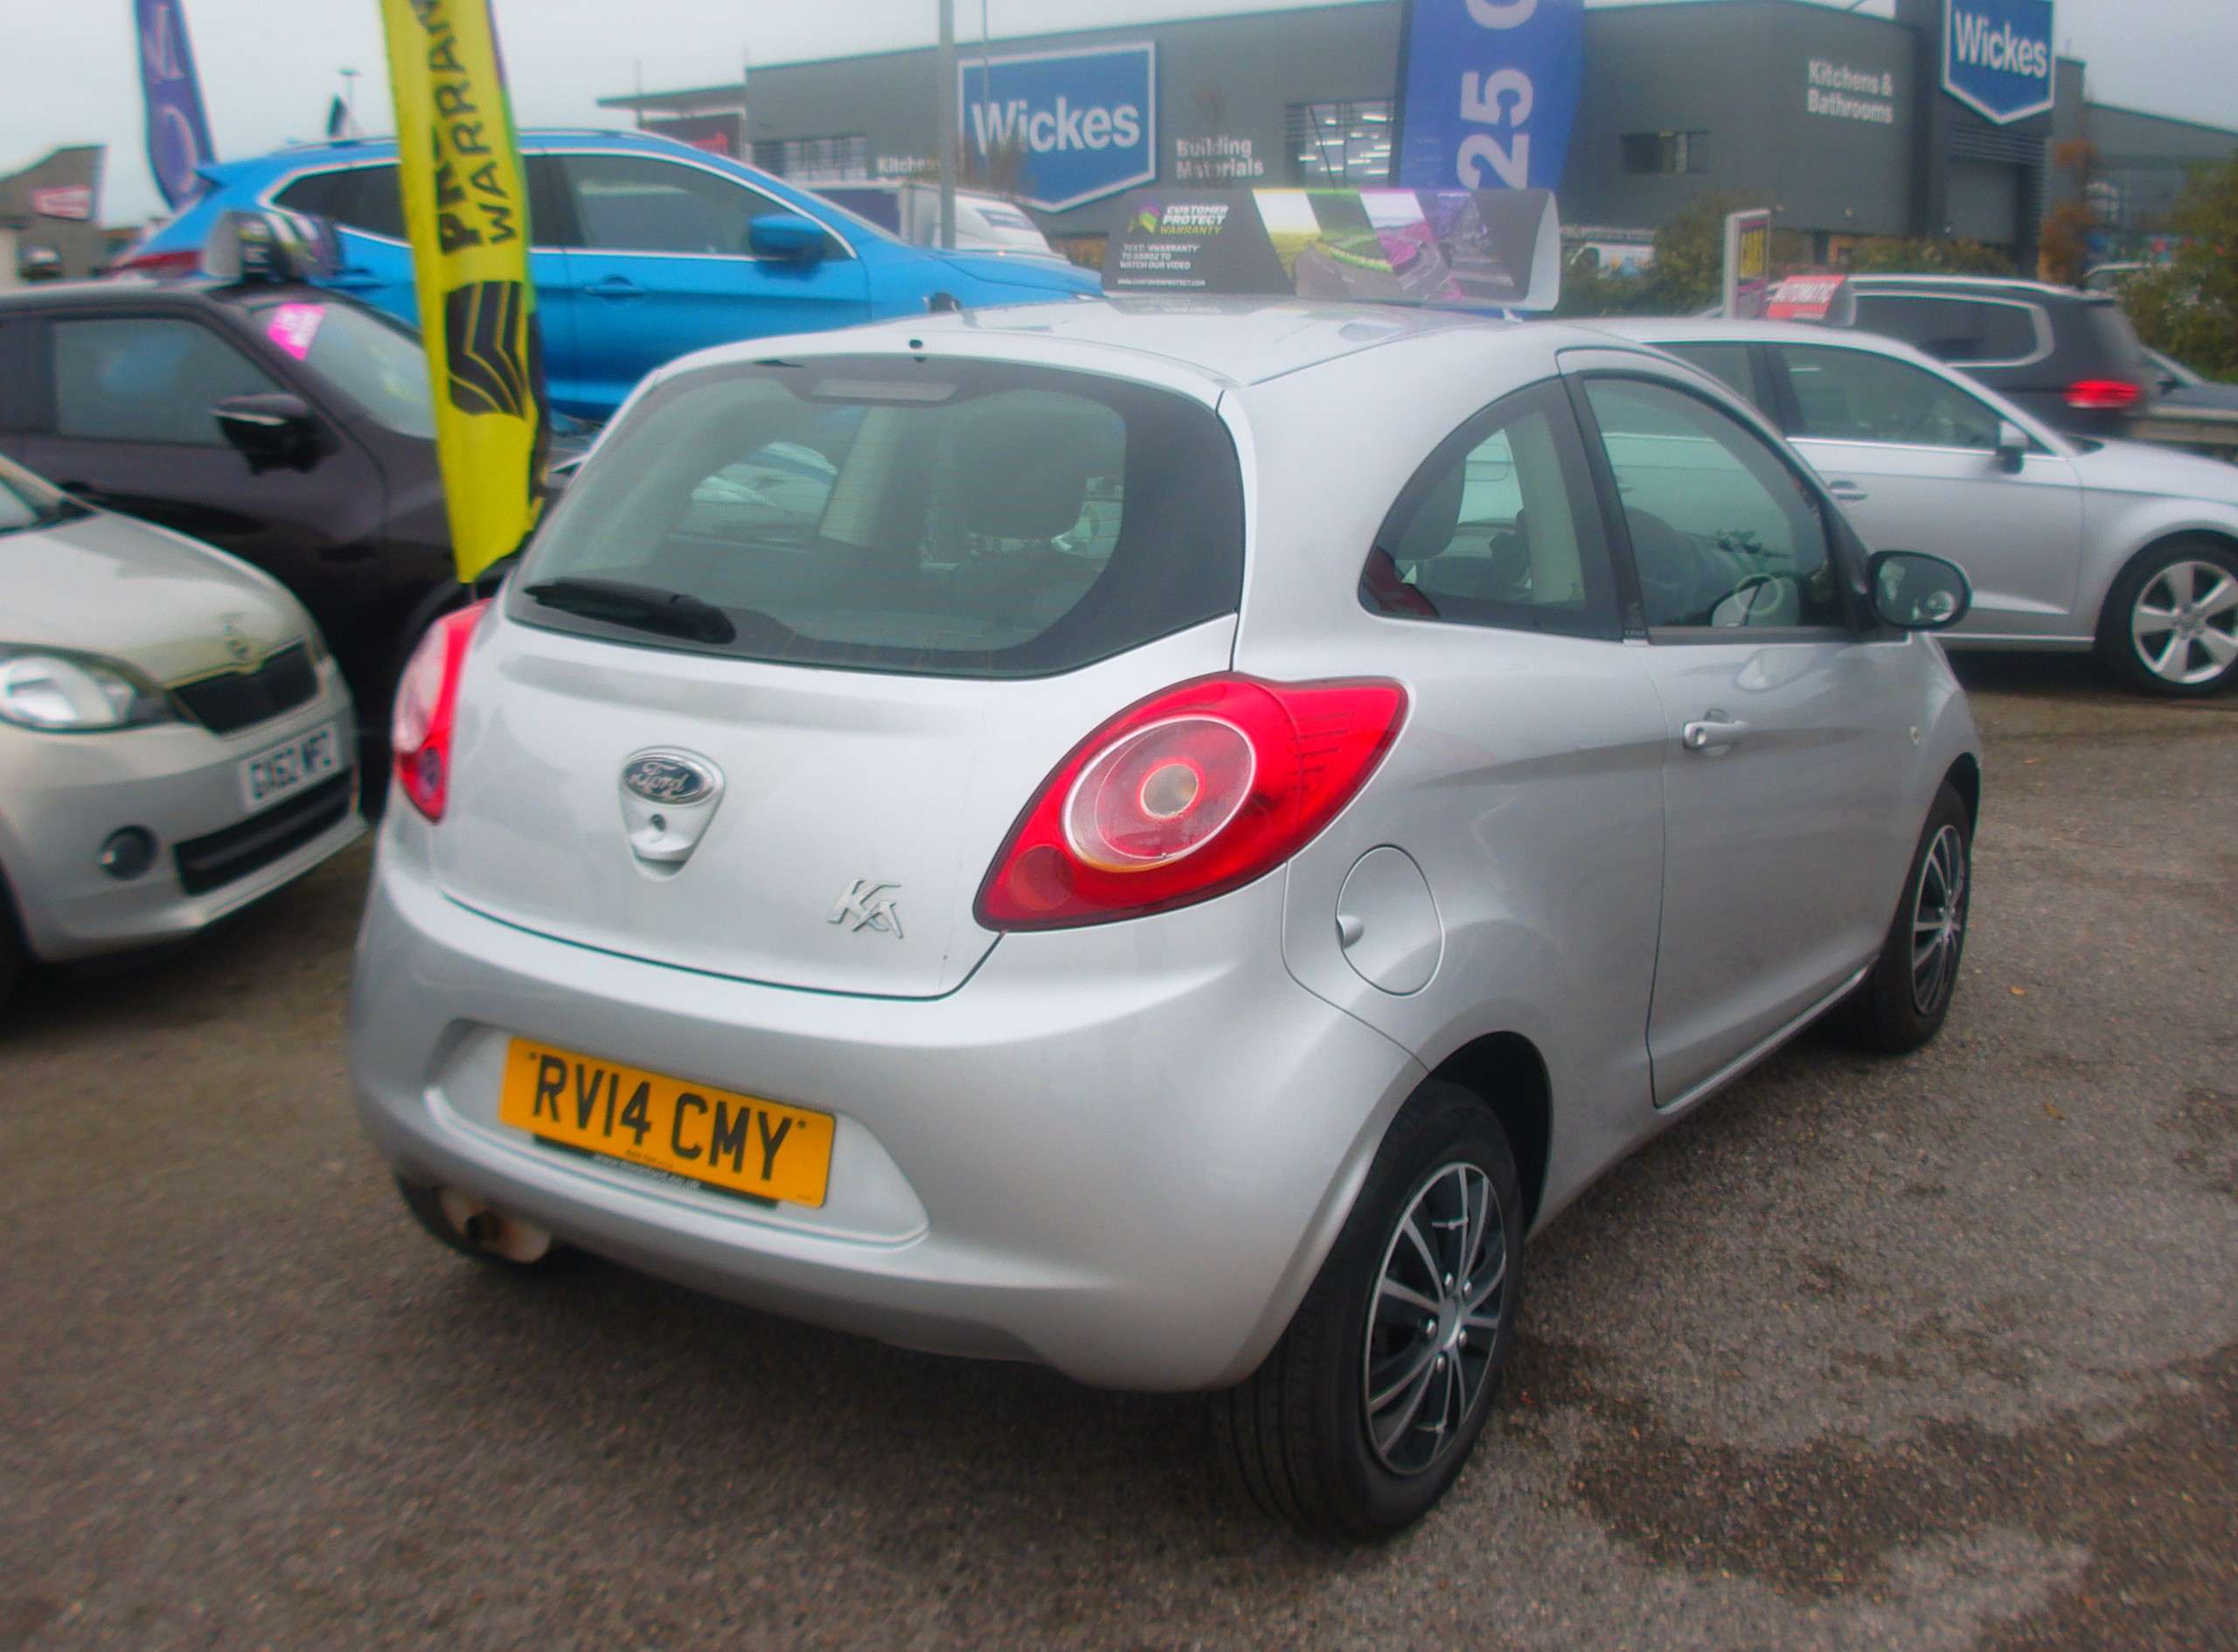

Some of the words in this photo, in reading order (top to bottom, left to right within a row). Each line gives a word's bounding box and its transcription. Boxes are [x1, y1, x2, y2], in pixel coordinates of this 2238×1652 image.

[1955, 10, 2047, 80] Wickes
[1807, 59, 1880, 93] Kitchens
[1880, 72, 1894, 97] &
[1807, 87, 1894, 124] Bathrooms
[971, 96, 1141, 156] Wickes
[1456, 68, 1534, 190] 25
[1175, 136, 1253, 158] Building
[1162, 214, 1226, 225] PROTECT
[1165, 205, 1229, 215] CUSTOMER
[1160, 226, 1223, 235] WARRANTY
[627, 761, 692, 795] Ford
[532, 1052, 653, 1147] RV14
[671, 1092, 793, 1182] CMY
